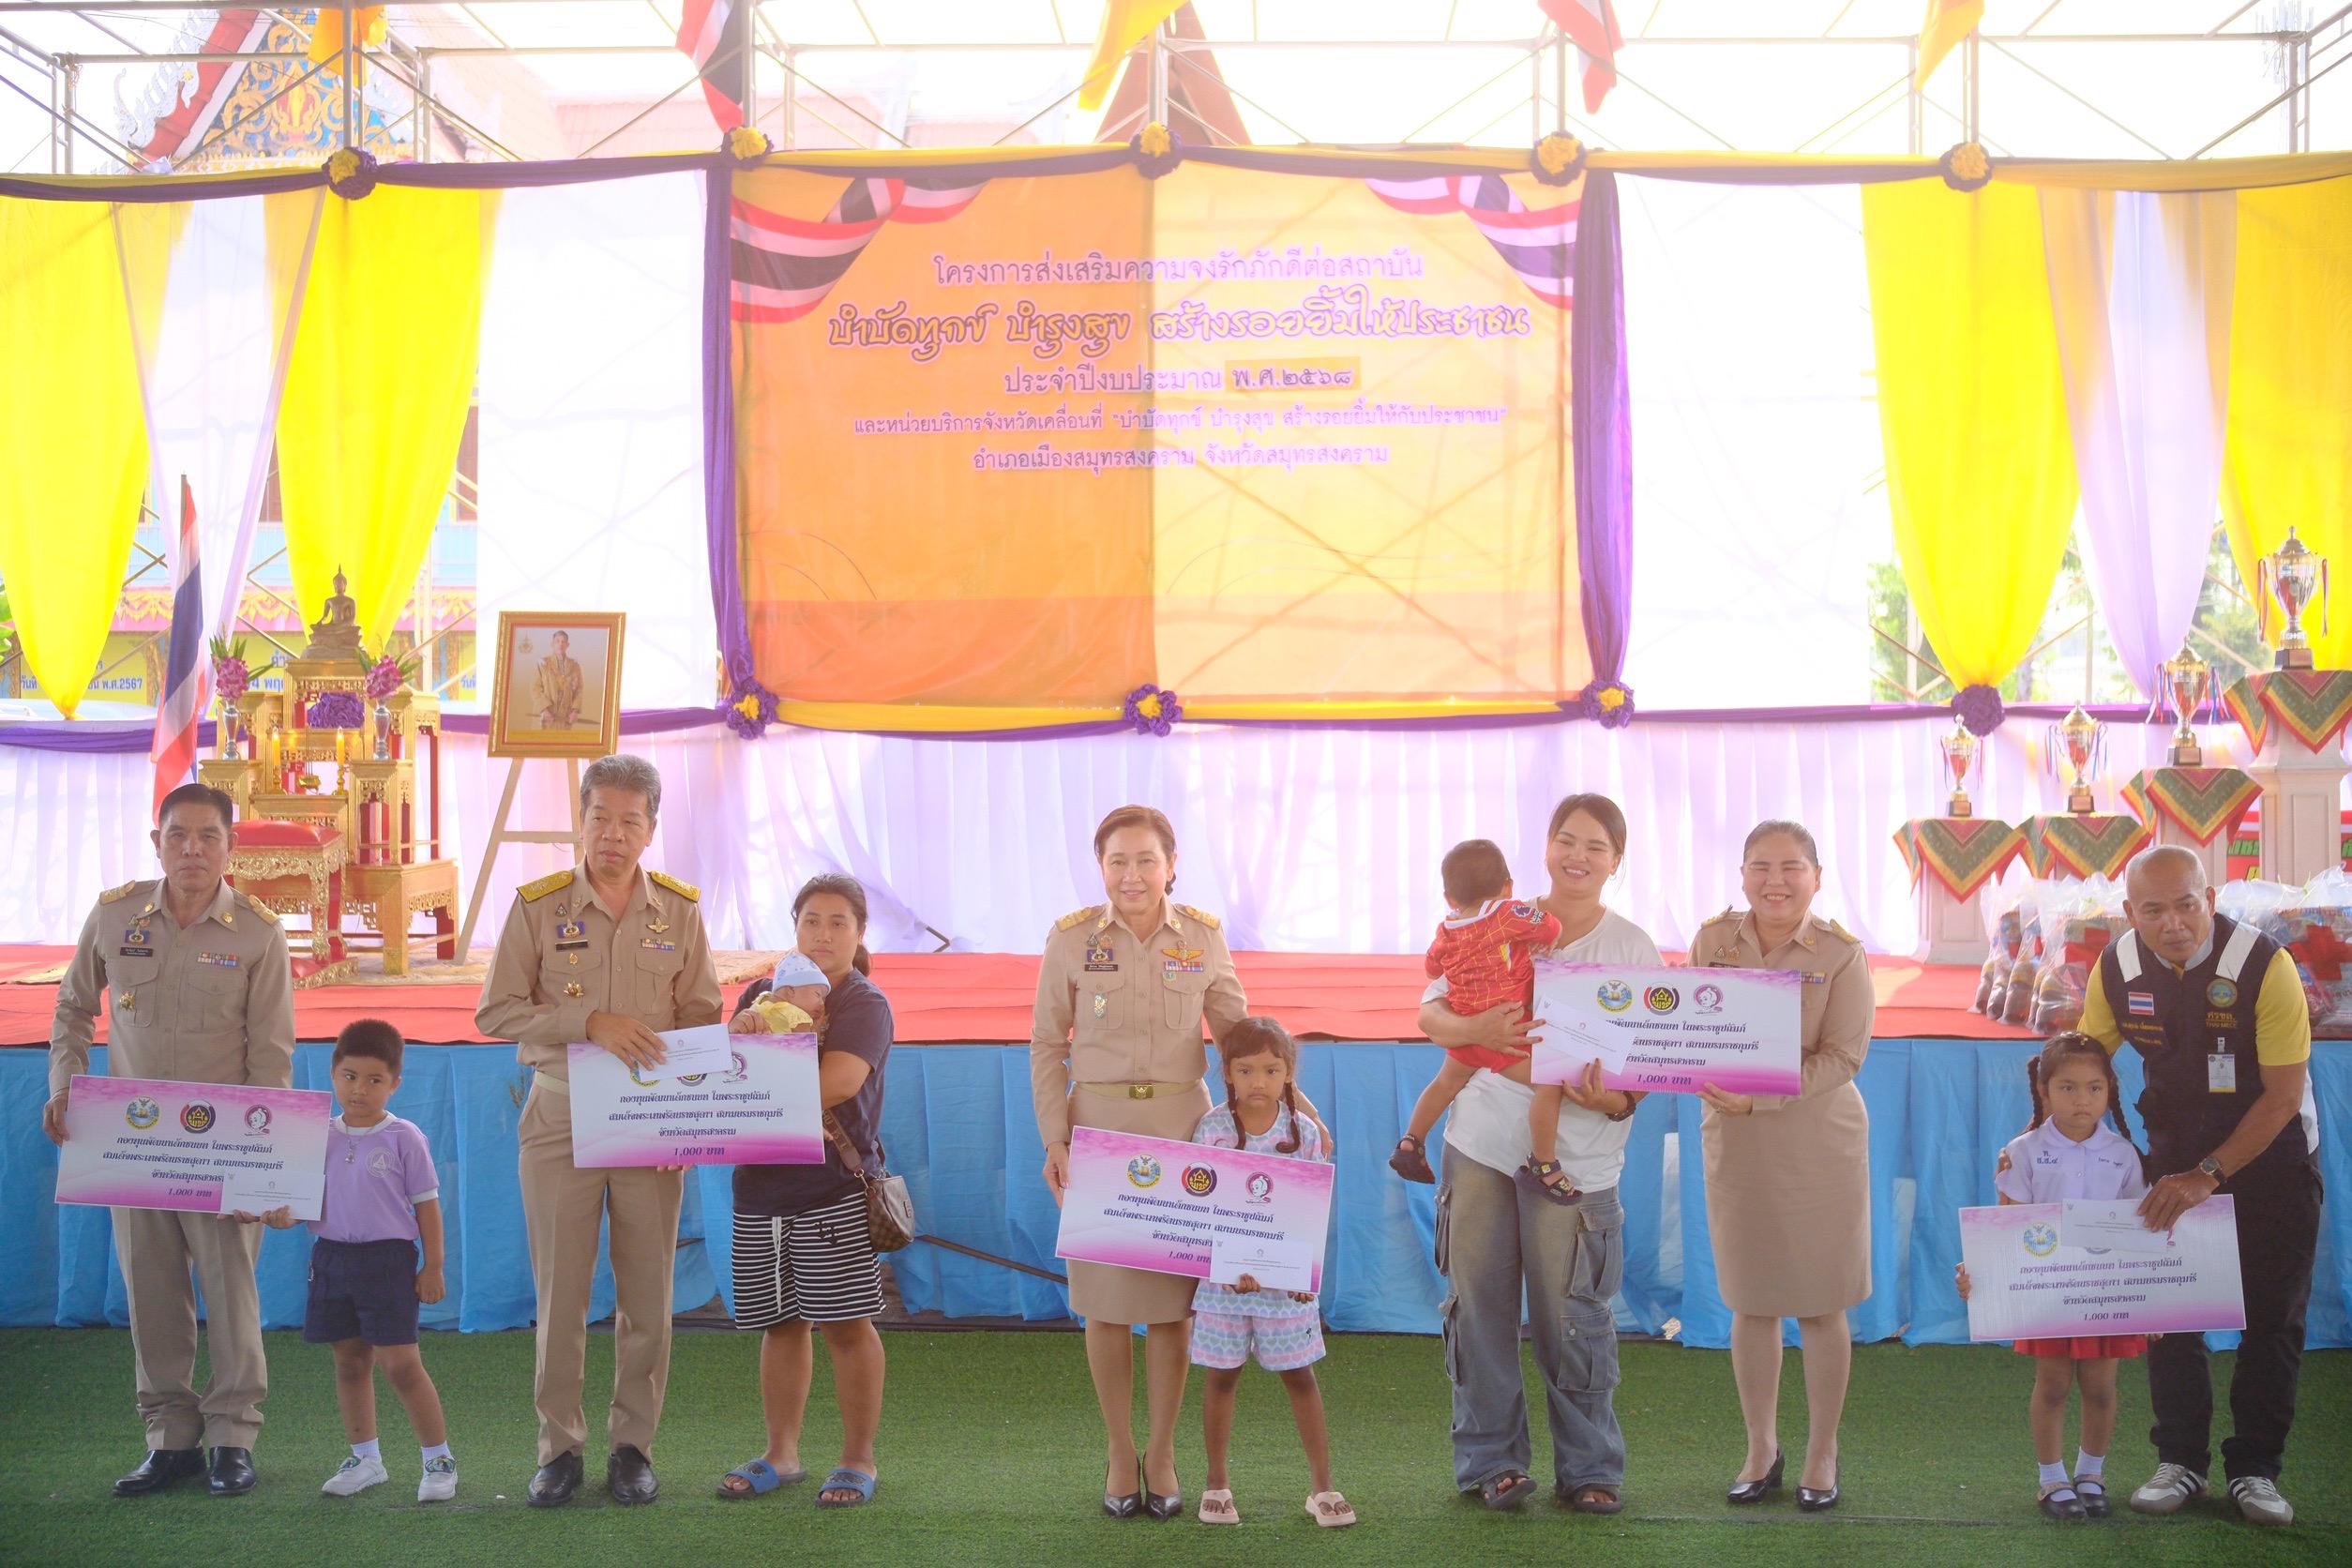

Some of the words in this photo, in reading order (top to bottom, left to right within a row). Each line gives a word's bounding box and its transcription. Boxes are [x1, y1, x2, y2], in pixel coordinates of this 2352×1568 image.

[933, 248, 1423, 283] โครงการส่งเสริมความจงรักภักดีต่อสถาบัน
[829, 301, 998, 361] บำบัดทุกข์
[1007, 300, 1131, 358] บำรุงสุข
[1151, 284, 1530, 339] สร้างรอยยิ้มให้ประชาชน
[1004, 363, 1222, 393] ประจำปีงบประมาณ
[1232, 368, 1351, 389] พ.ศ.๒๕๖๘
[854, 402, 1103, 433] และหน่วยบริการจังหวัดเคลื่อนที่
[1210, 408, 1274, 434] บำรุงสุข
[973, 444, 1195, 475] อำเภอเมืองสมุทรสงคราม
[1204, 442, 1389, 473] จังหวัดสมุทรสงคราม
[1672, 1077, 1692, 1085] บาท
[706, 1147, 725, 1155] บาท
[196, 1188, 212, 1198] บาท
[2113, 1311, 2129, 1319] บาท
